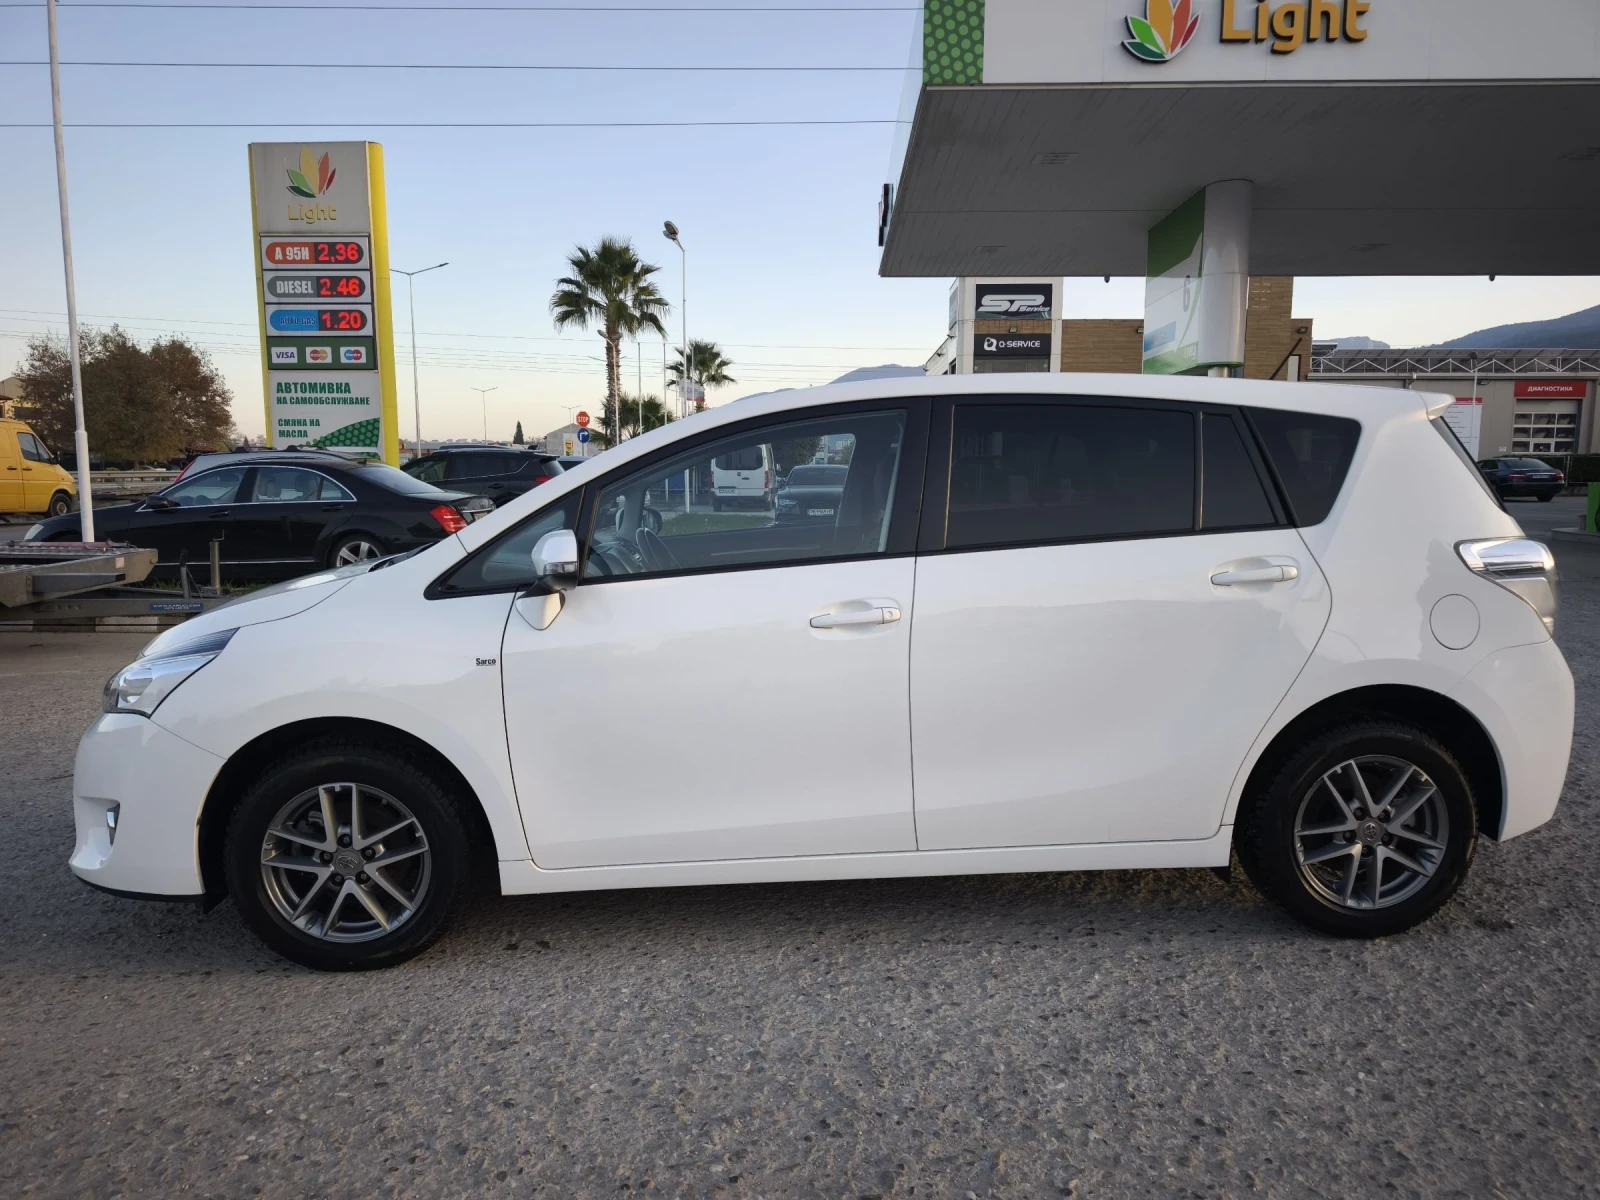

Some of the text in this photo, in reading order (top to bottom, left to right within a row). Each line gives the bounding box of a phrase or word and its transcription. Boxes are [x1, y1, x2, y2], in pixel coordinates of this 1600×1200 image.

[1221, 0, 1370, 53] Light
[288, 203, 336, 224] Light
[276, 280, 314, 294] DIESEL
[320, 278, 360, 296] 2.46
[1183, 274, 1190, 312] 6
[977, 294, 1045, 312] SP
[301, 316, 316, 325] GAS
[322, 312, 362, 328] 1.20
[276, 382, 351, 394] АВТОМИВКА
[289, 397, 370, 406] САМООБСЛУЖВАНЕ
[278, 418, 320, 427] СМЯНА НА
[278, 430, 308, 438] МАСЛА
